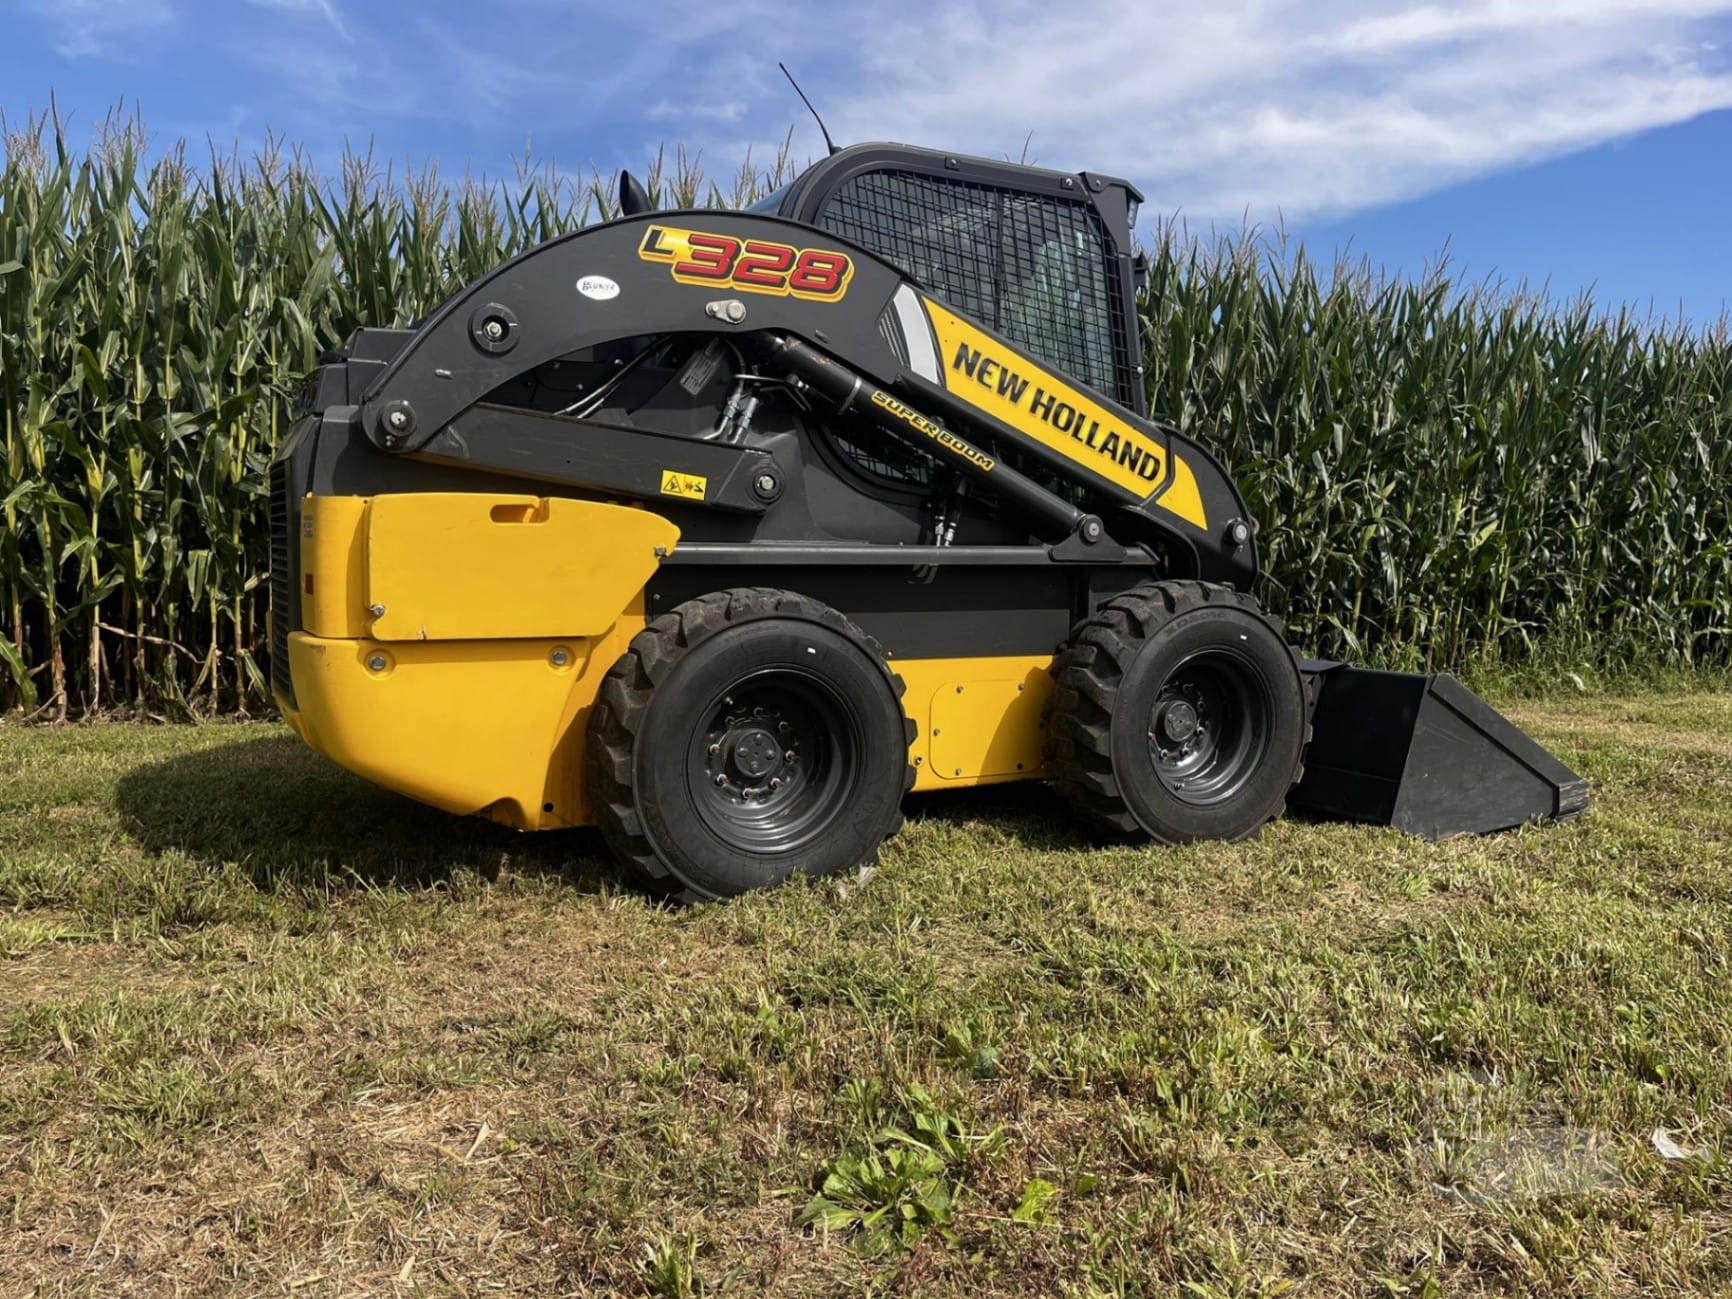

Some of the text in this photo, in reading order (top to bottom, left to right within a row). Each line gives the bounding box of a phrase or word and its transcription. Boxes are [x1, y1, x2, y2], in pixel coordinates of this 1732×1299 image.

[641, 226, 853, 299] L328
[872, 391, 994, 470] SUPER BOOM
[952, 342, 1162, 482] NEW HOLLAND
